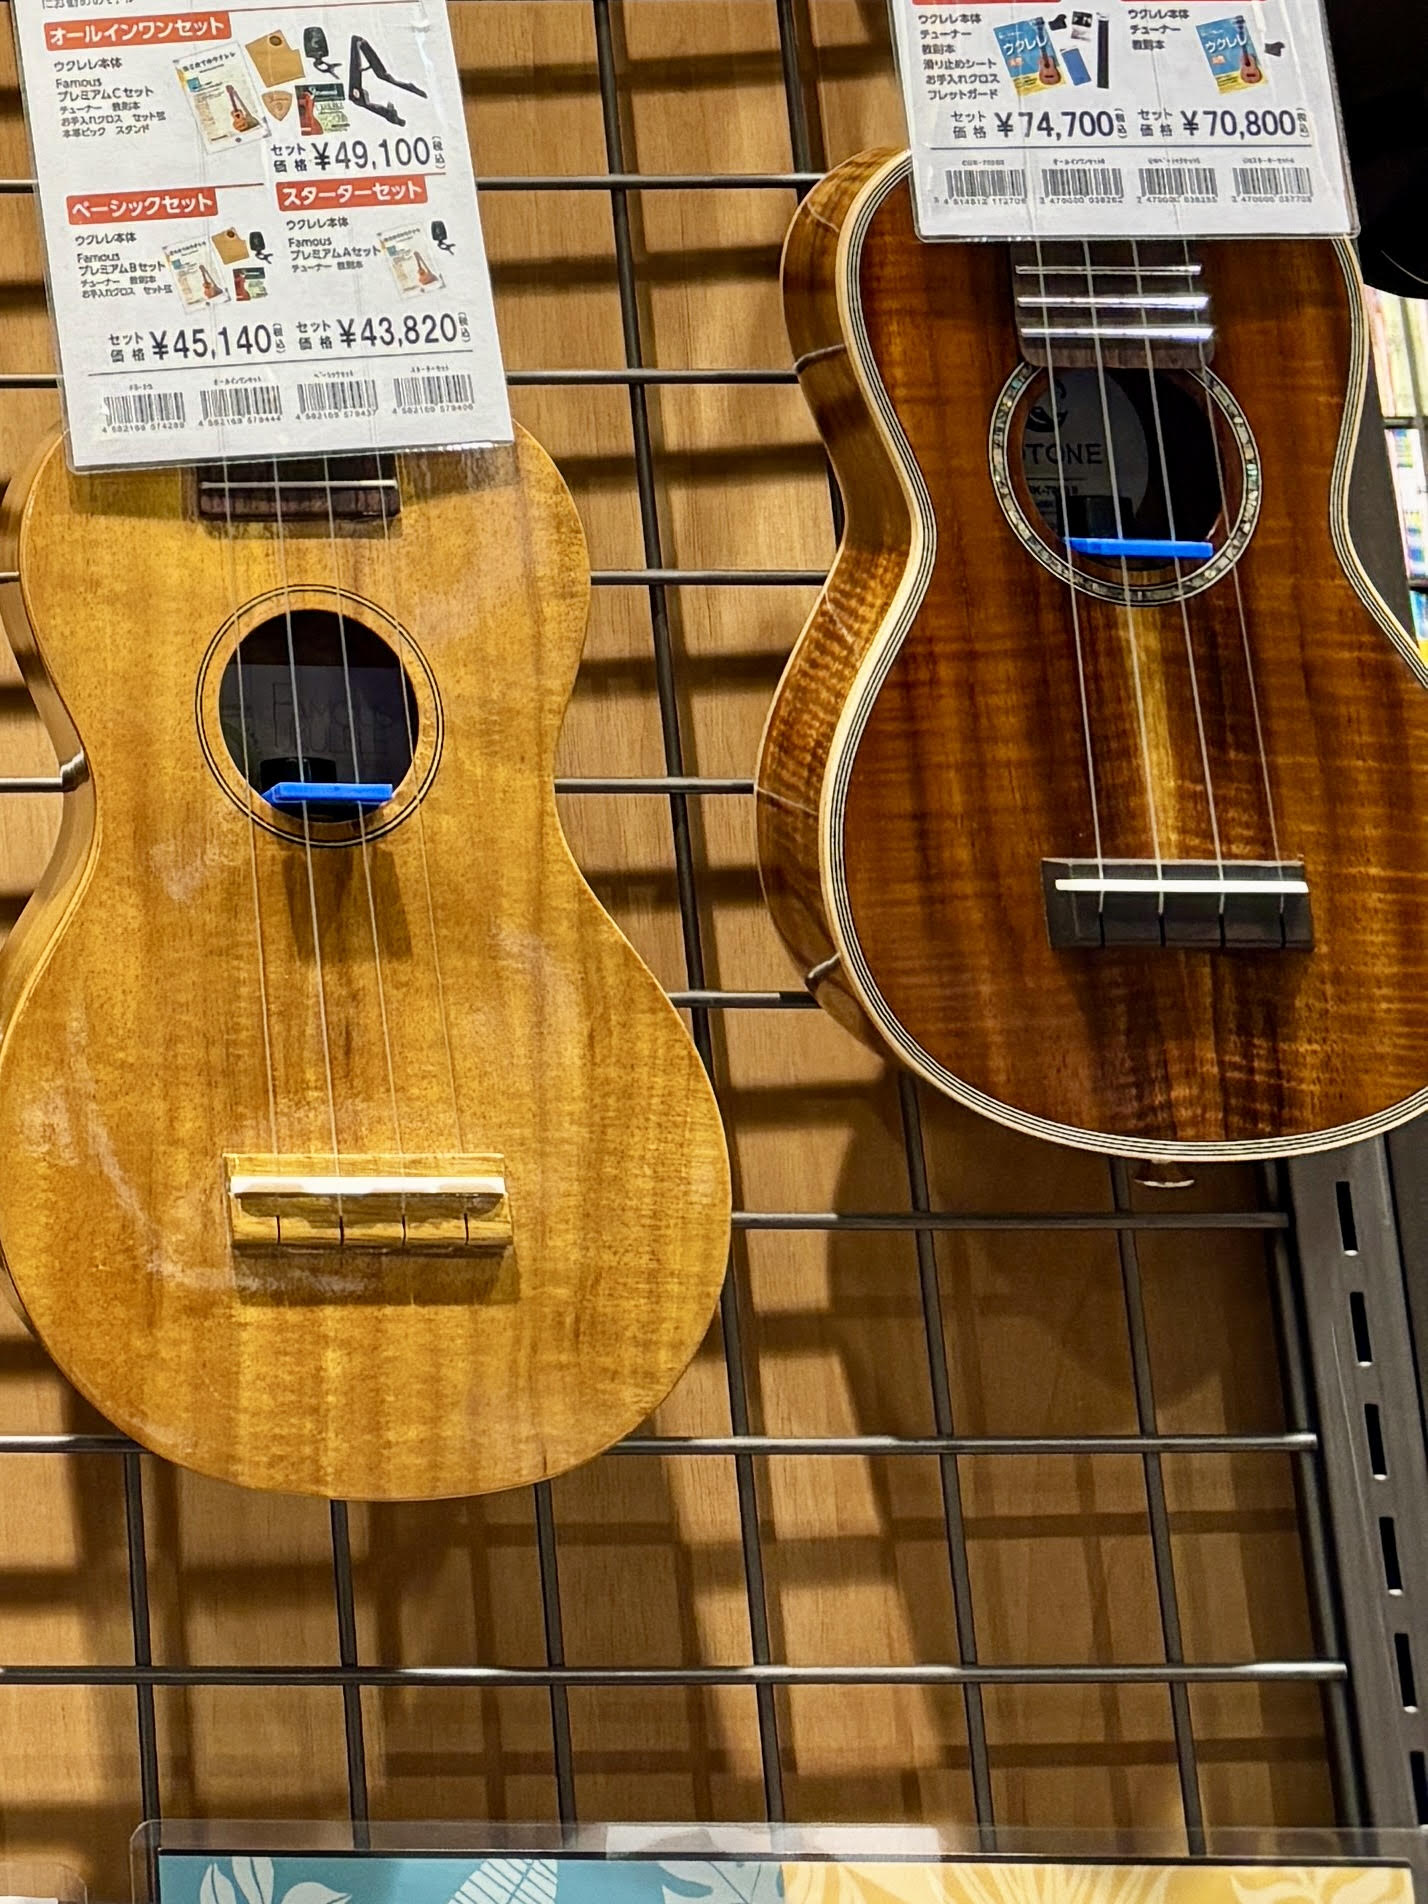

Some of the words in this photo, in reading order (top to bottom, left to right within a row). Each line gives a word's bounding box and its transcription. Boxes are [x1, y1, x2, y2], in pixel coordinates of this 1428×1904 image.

[48, 15, 225, 46] オールインワンセット
[994, 110, 1116, 140] ¥74,700
[1180, 108, 1297, 138] ¥70,800
[311, 135, 431, 174] ¥49,100
[70, 192, 215, 221] ベーシックセット
[281, 180, 423, 208] スターターセット
[149, 323, 274, 363] ¥45,140
[337, 312, 459, 350] ¥43,820
